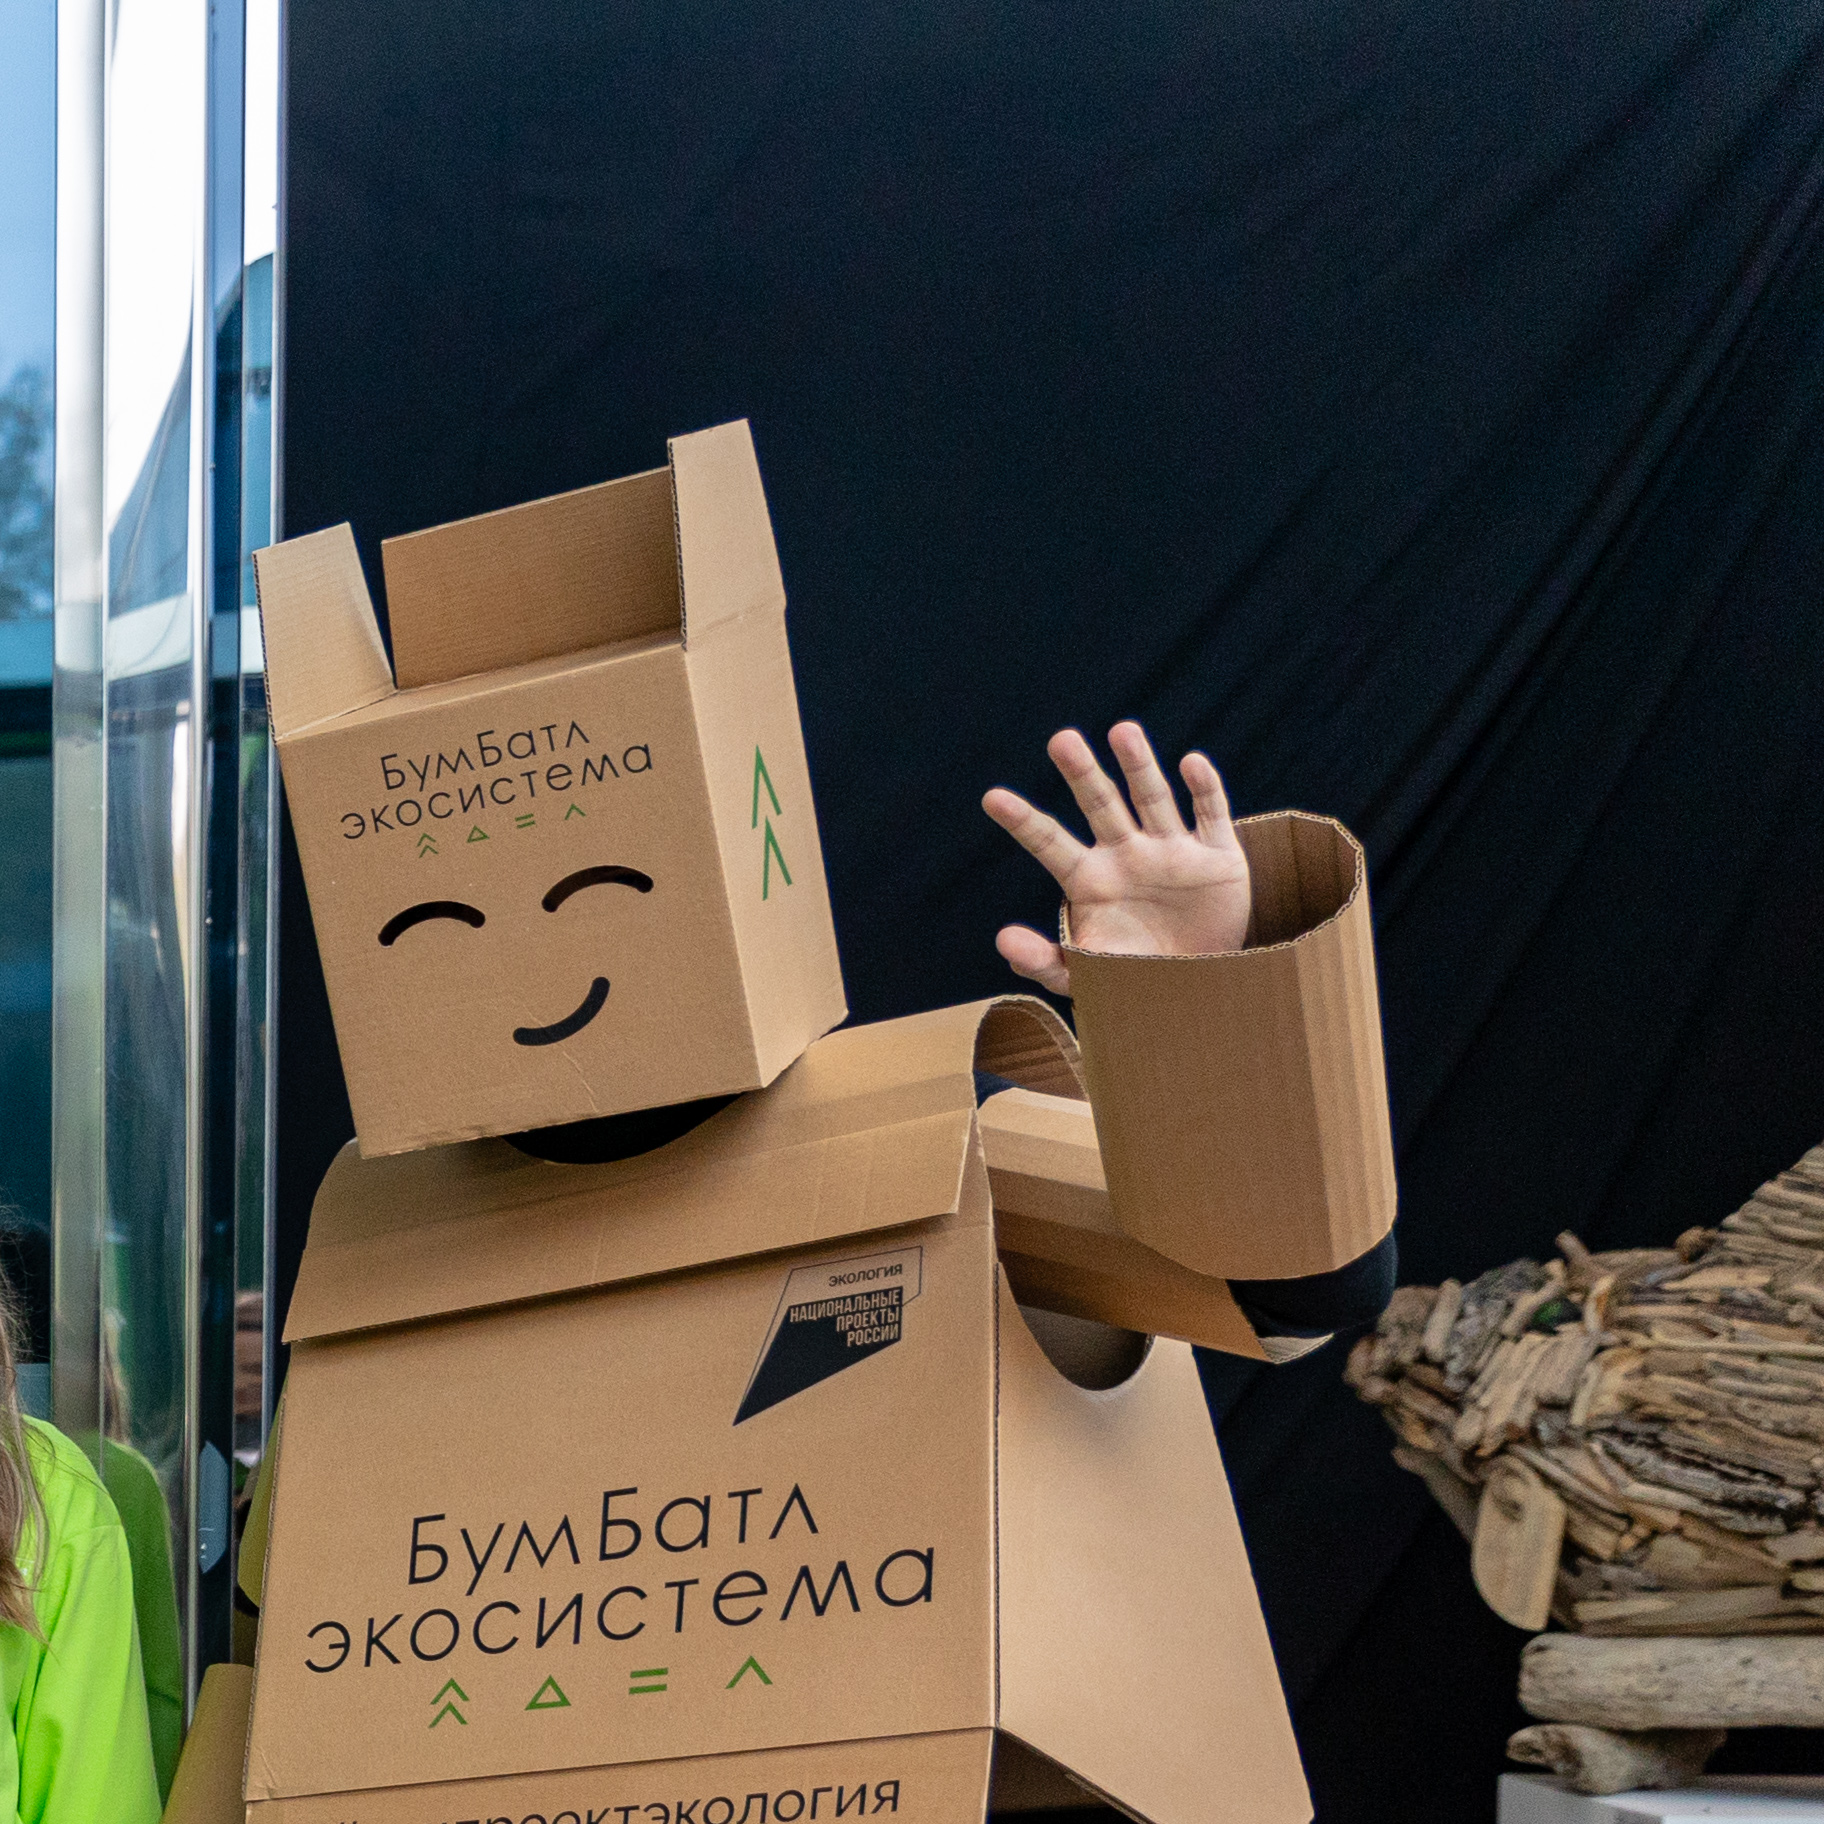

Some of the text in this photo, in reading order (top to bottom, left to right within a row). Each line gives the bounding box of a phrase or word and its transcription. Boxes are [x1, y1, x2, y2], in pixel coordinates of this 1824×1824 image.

[340, 742, 653, 840] экосистема
[380, 720, 590, 792] БумБатл
[789, 1288, 901, 1323] НАЦИОНАЛЬНЫЕ
[836, 1306, 900, 1332] ПРОЕКТЫ
[846, 1323, 900, 1348] РОССИИ
[407, 1483, 820, 1597] БумБатл
[304, 1547, 936, 1674] экосистема
